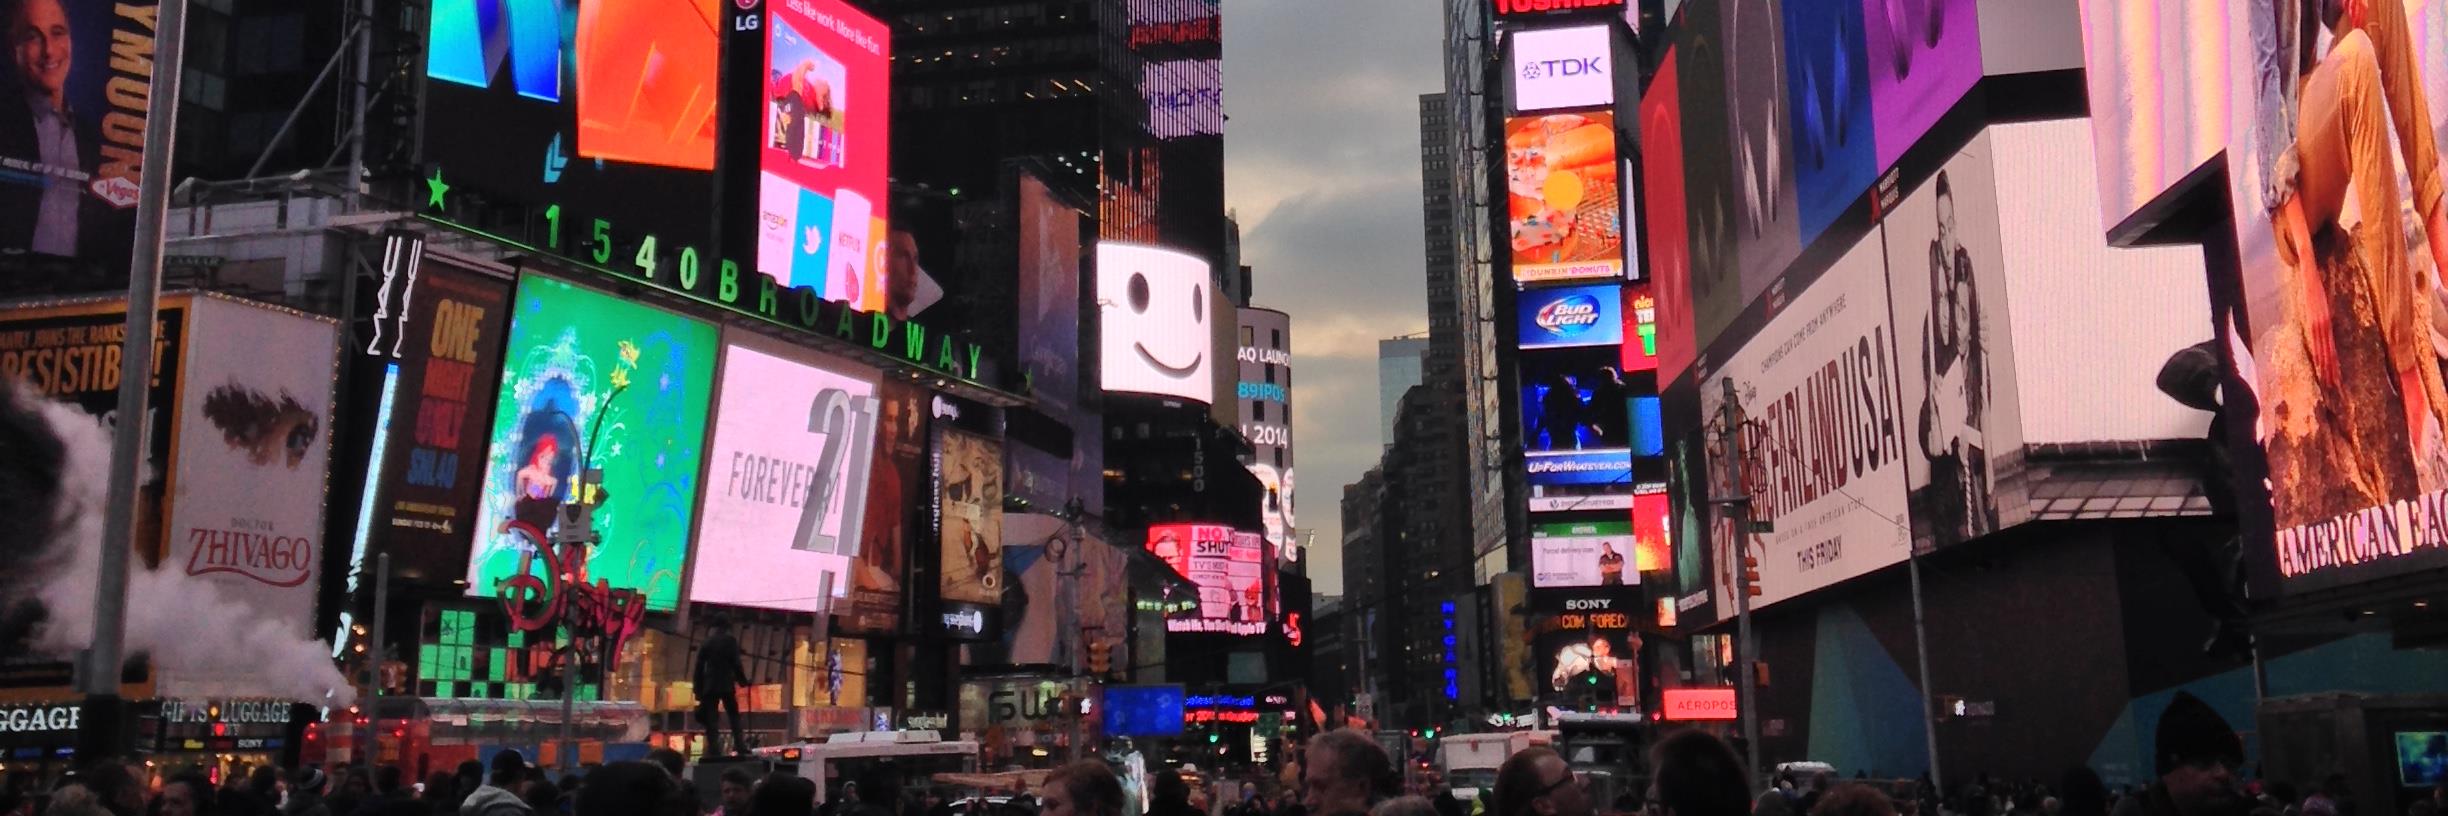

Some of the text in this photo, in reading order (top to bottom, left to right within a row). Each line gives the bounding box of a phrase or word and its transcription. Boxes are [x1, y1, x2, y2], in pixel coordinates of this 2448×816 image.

[735, 14, 759, 32] LG
[1541, 56, 1603, 77] TDK
[1547, 312, 1599, 326] LIGHT
[1554, 303, 1594, 316] BUD
[430, 297, 485, 364] ONE
[1237, 346, 1257, 364] AQ
[1842, 324, 1898, 478] USA
[1253, 425, 1288, 449] 2014
[791, 387, 880, 558] 21
[187, 527, 311, 577] ZHIVAGO
[2275, 503, 2403, 578] AMERICAN
[1797, 534, 1842, 574] THIS FRIDAY
[1565, 599, 1612, 610] SONY
[219, 700, 291, 723] LUGGAGE
